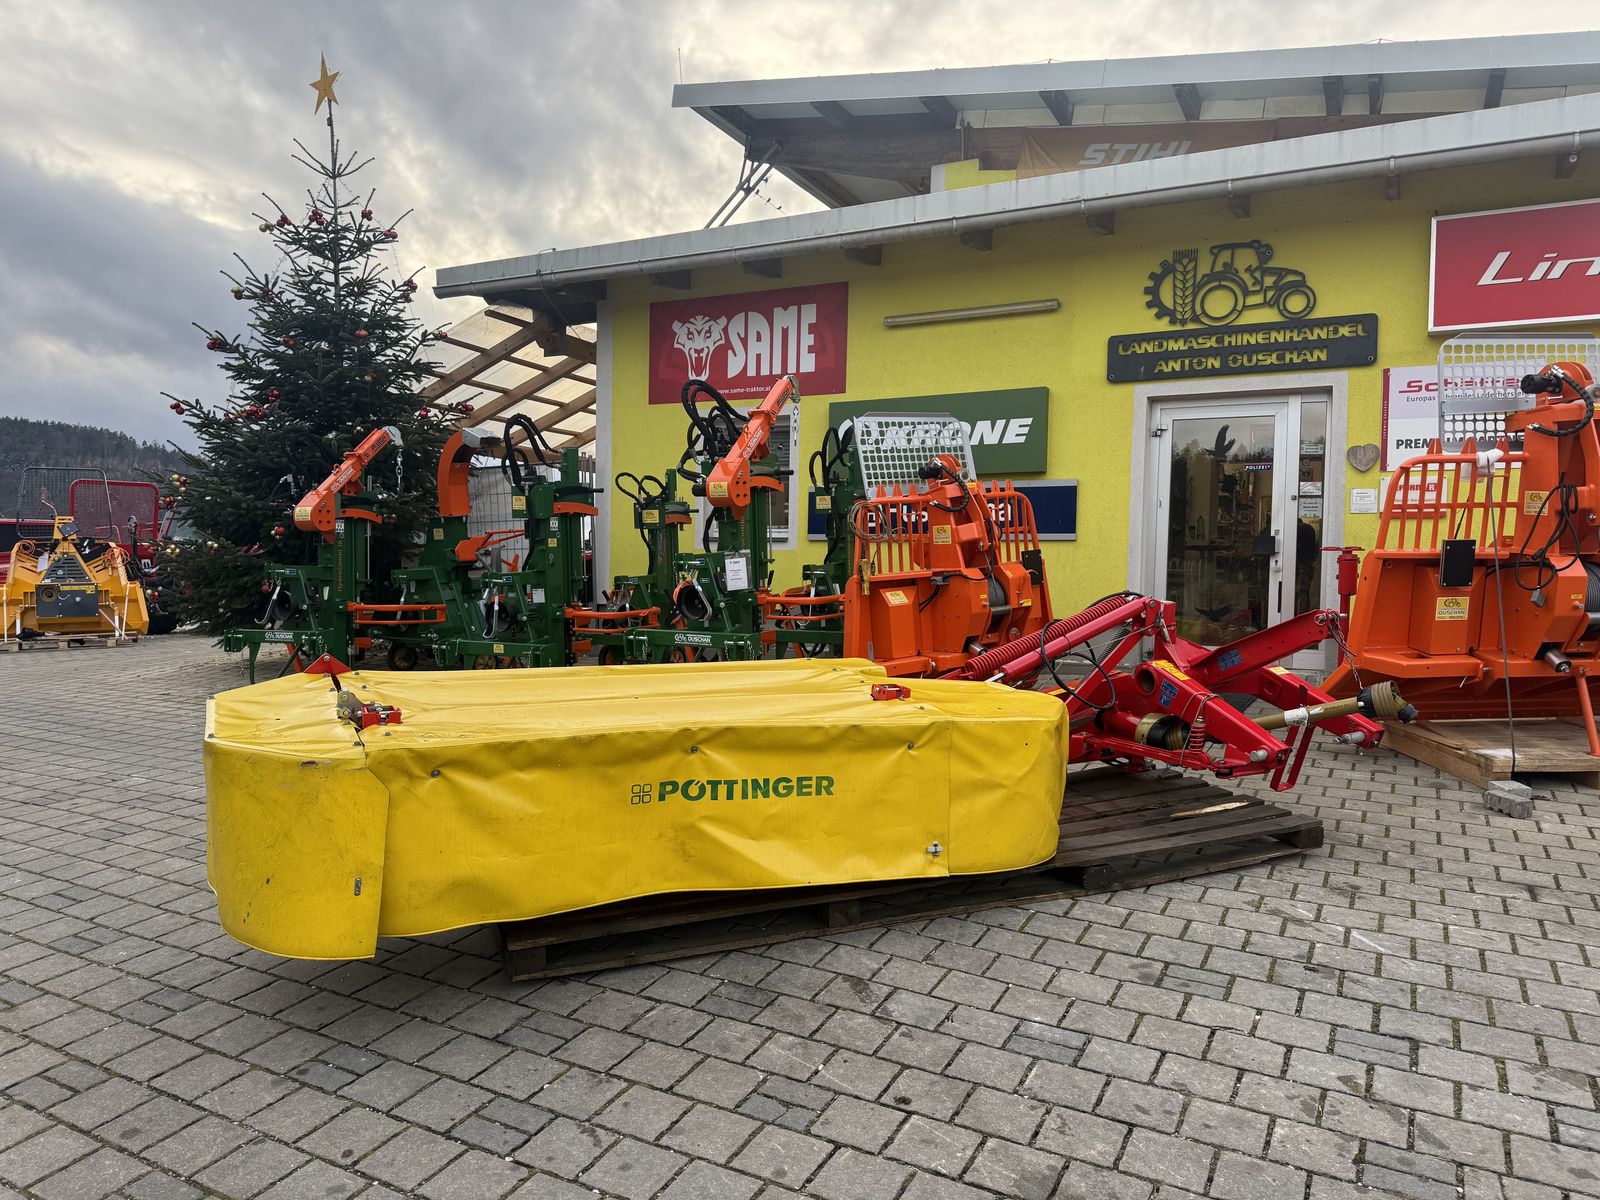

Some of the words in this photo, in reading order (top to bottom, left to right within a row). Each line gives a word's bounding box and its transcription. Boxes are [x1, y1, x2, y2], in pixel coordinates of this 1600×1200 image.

[727, 303, 817, 379] SAME
[1118, 321, 1368, 355] LANDMASCHINENHANDEL
[1154, 355, 1221, 374] ANTON
[1227, 347, 1328, 368] OUSCHAN
[1406, 395, 1436, 403] Europas
